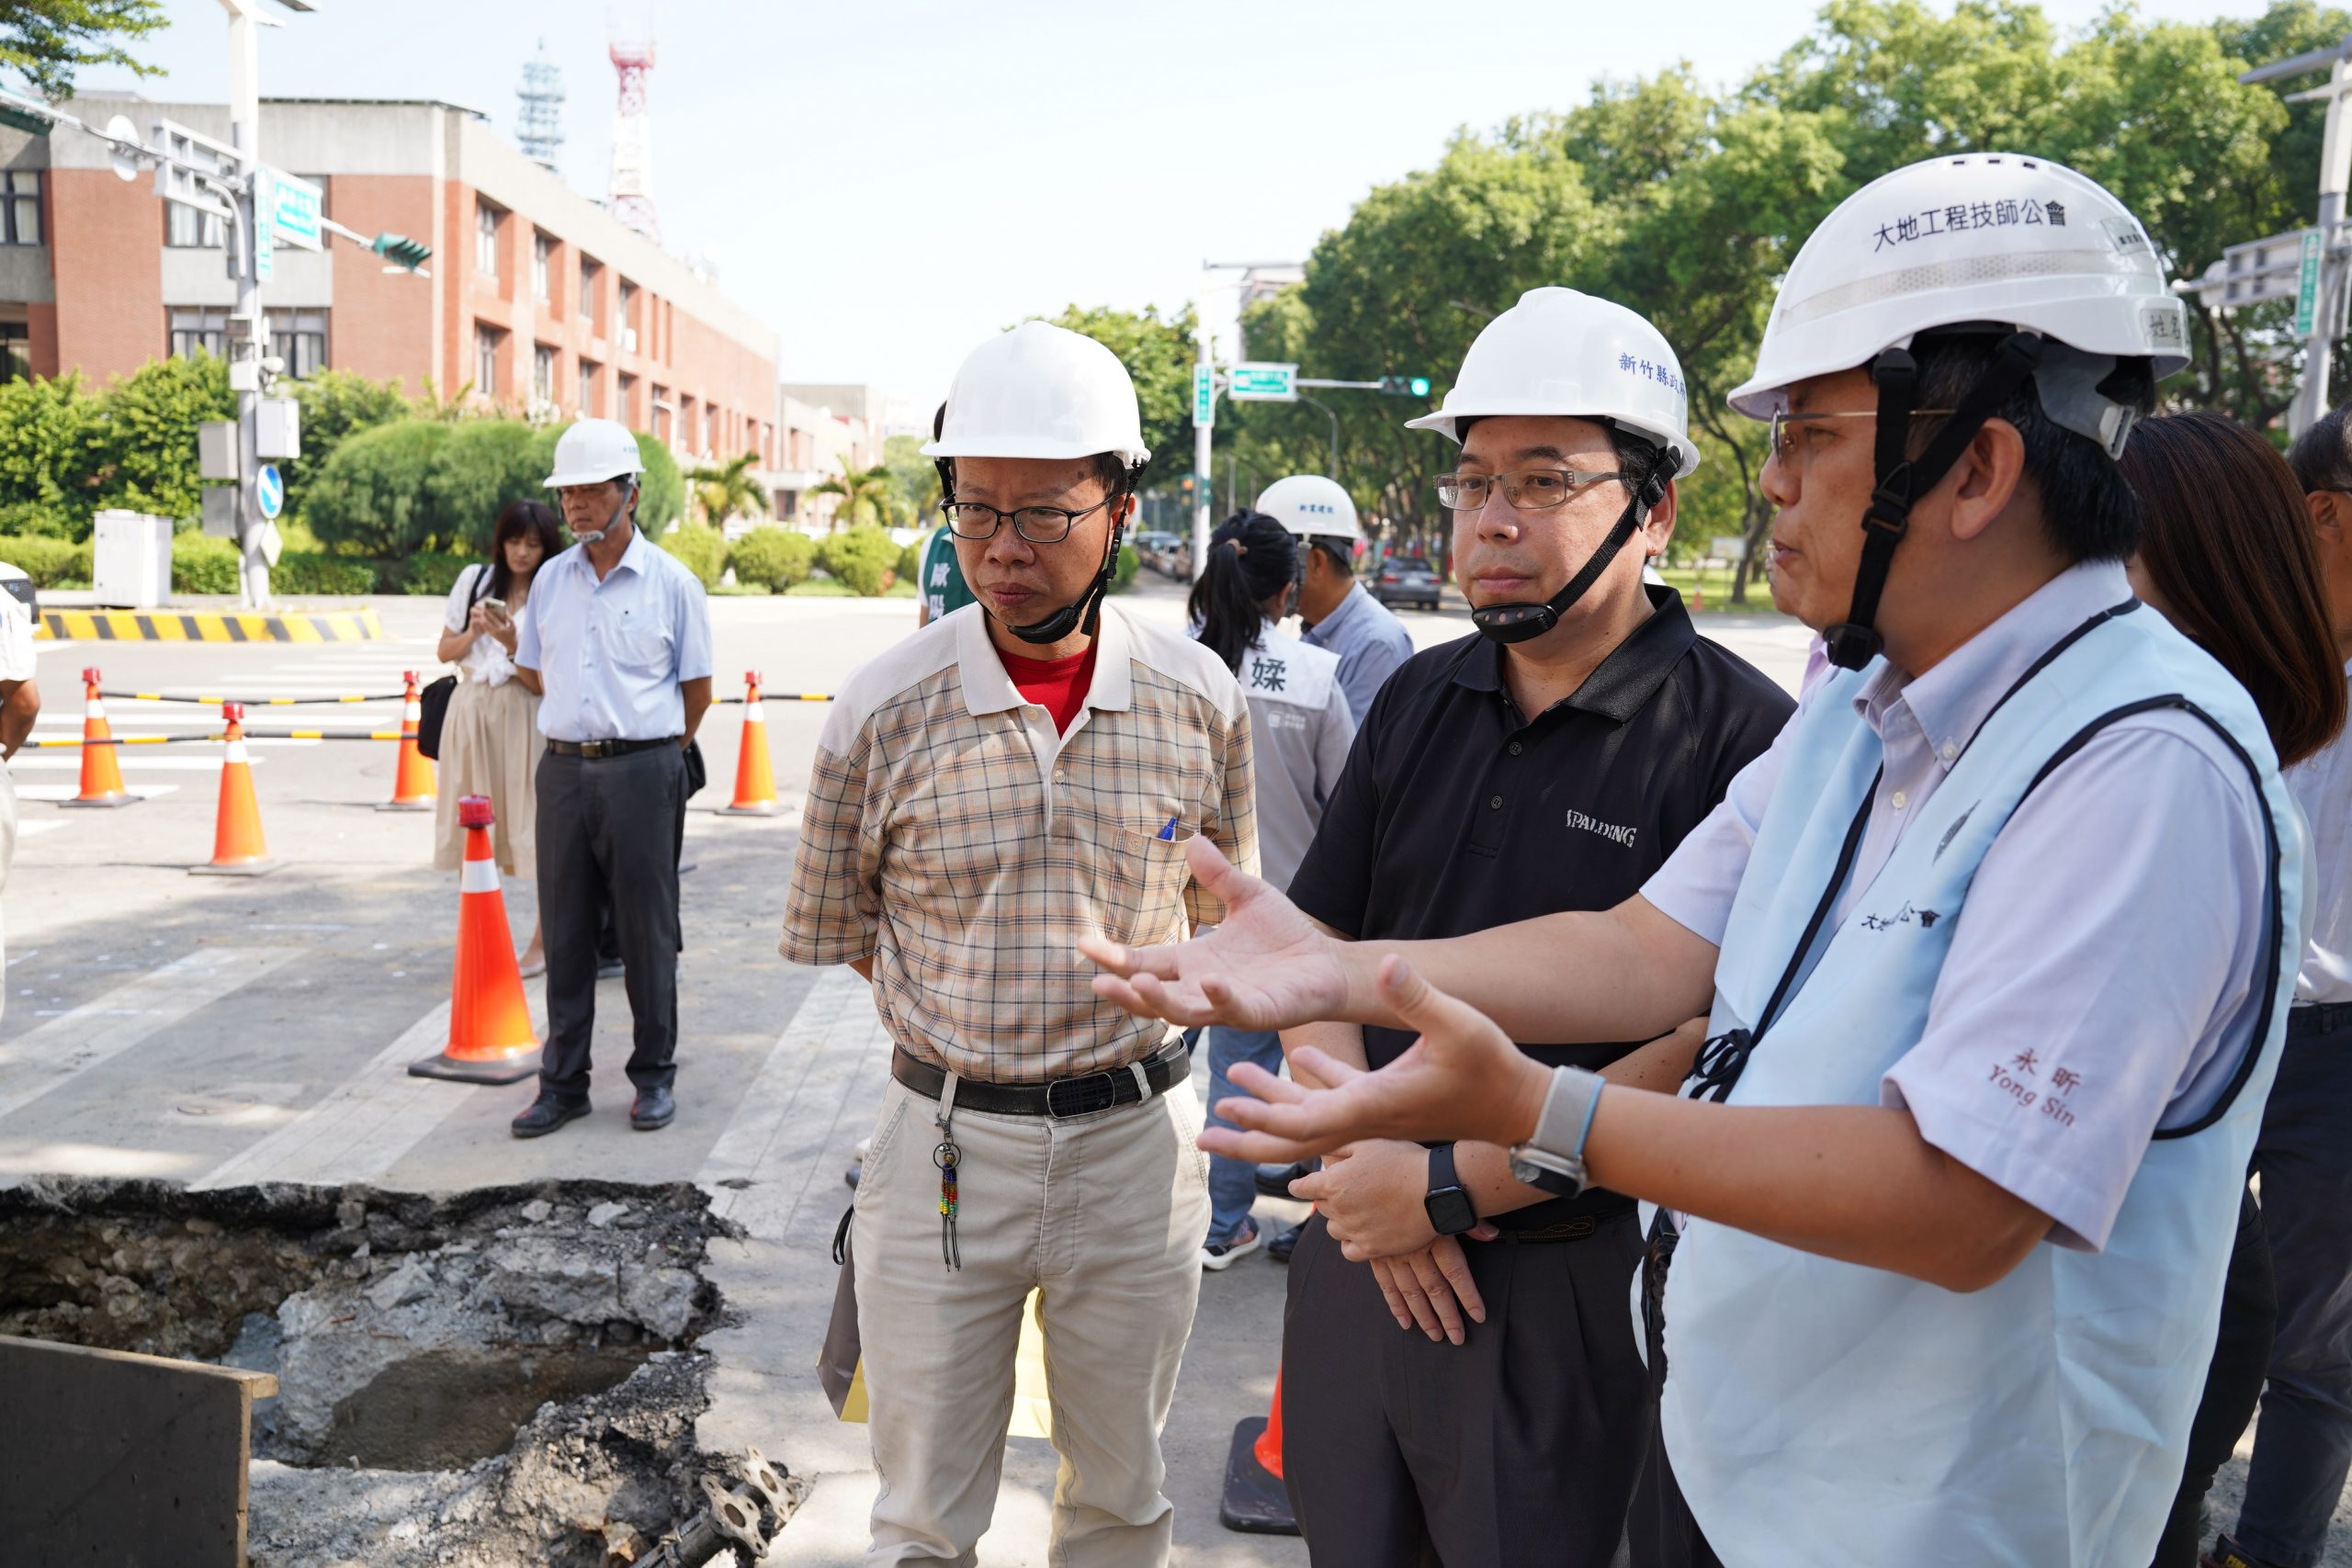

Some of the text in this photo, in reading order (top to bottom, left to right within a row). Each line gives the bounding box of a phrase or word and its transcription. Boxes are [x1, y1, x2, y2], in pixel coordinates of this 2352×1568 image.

[1873, 198, 2066, 253] 大地工程技師公會
[1566, 809, 1637, 848] SPALDING
[1989, 1064, 2075, 1127] Yong Sin
